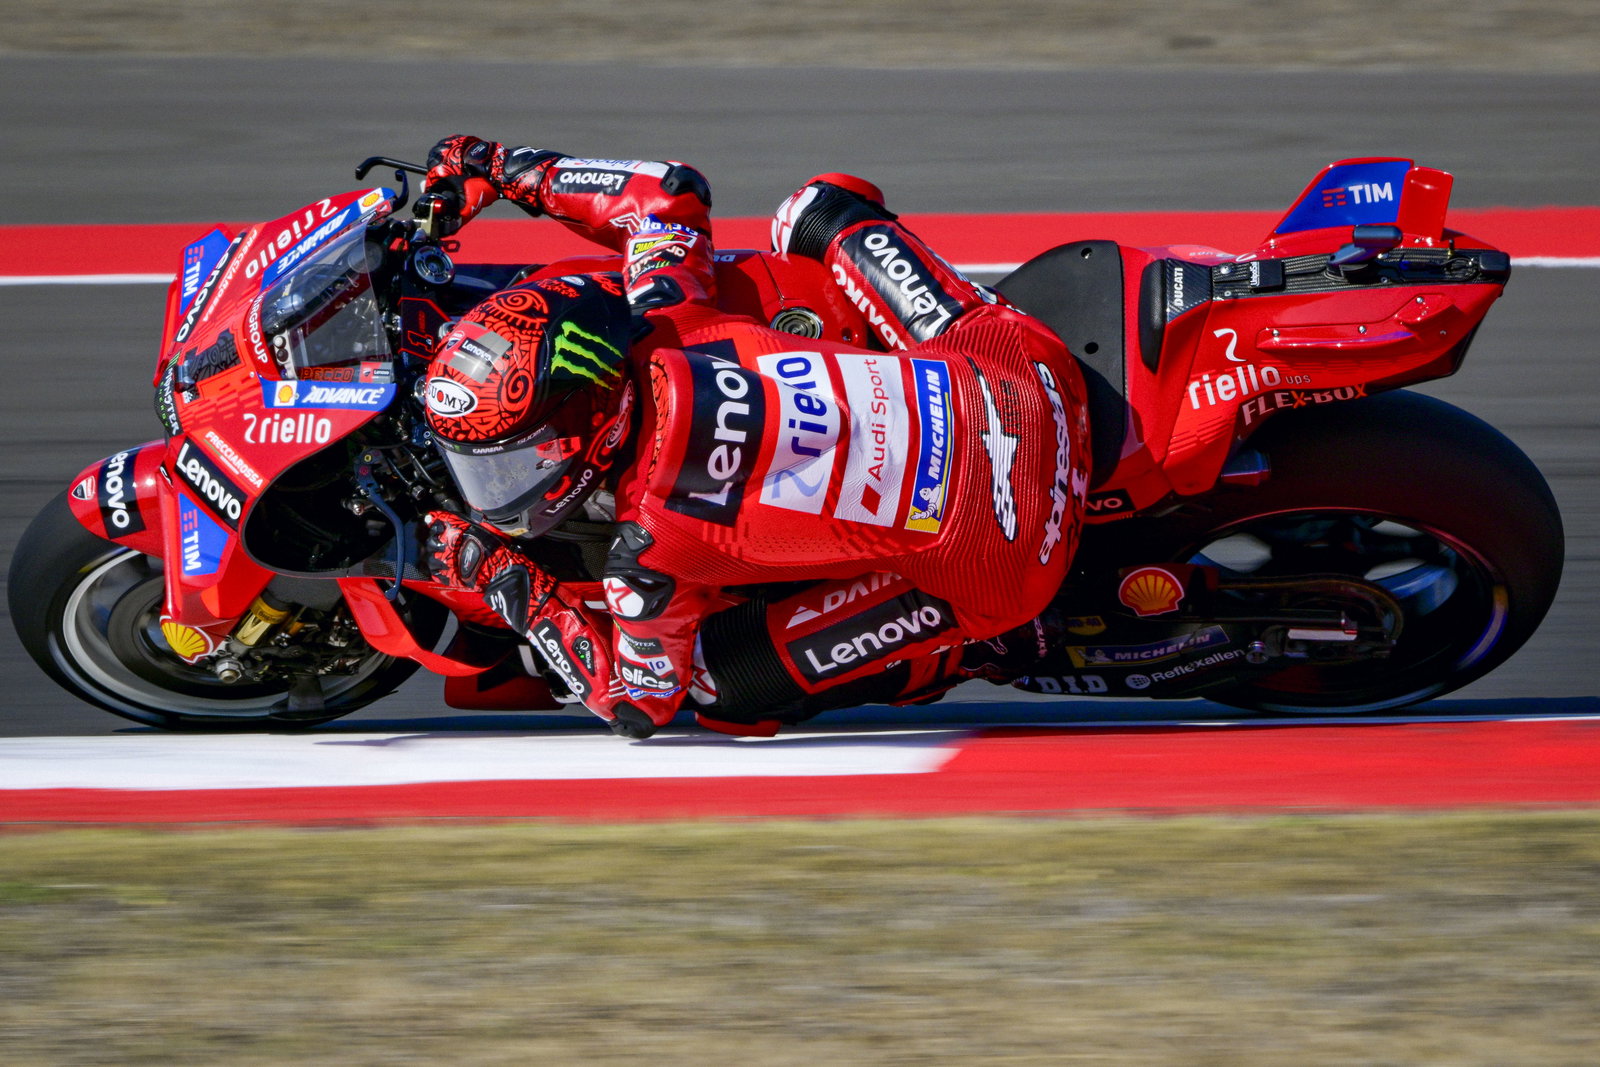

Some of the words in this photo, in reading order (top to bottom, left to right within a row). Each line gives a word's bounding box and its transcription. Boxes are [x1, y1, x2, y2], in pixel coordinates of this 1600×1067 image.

[559, 171, 625, 190] Lenovo
[1349, 182, 1393, 204] TIM
[277, 208, 350, 275] ADVANCE
[176, 236, 243, 342] Lenovo
[183, 262, 200, 297] TIM
[864, 233, 951, 337] Lenovo
[1174, 267, 1184, 307] DUCATI
[302, 386, 381, 405] ADVANCE
[776, 356, 827, 458] rielo
[863, 358, 890, 415] Sport
[1188, 364, 1281, 410] riello
[1241, 384, 1368, 426] FLEX-BOX
[259, 414, 331, 444] riello
[688, 355, 750, 506] Leno
[868, 422, 888, 482] Audi
[925, 369, 943, 480] MICHELIN
[176, 443, 241, 520] Lenovo
[205, 431, 263, 489] FRECCIAROSSA
[106, 452, 130, 528] enovo
[546, 468, 593, 515] Lenovo
[183, 531, 202, 572] TIM
[805, 606, 941, 674] Lenovo
